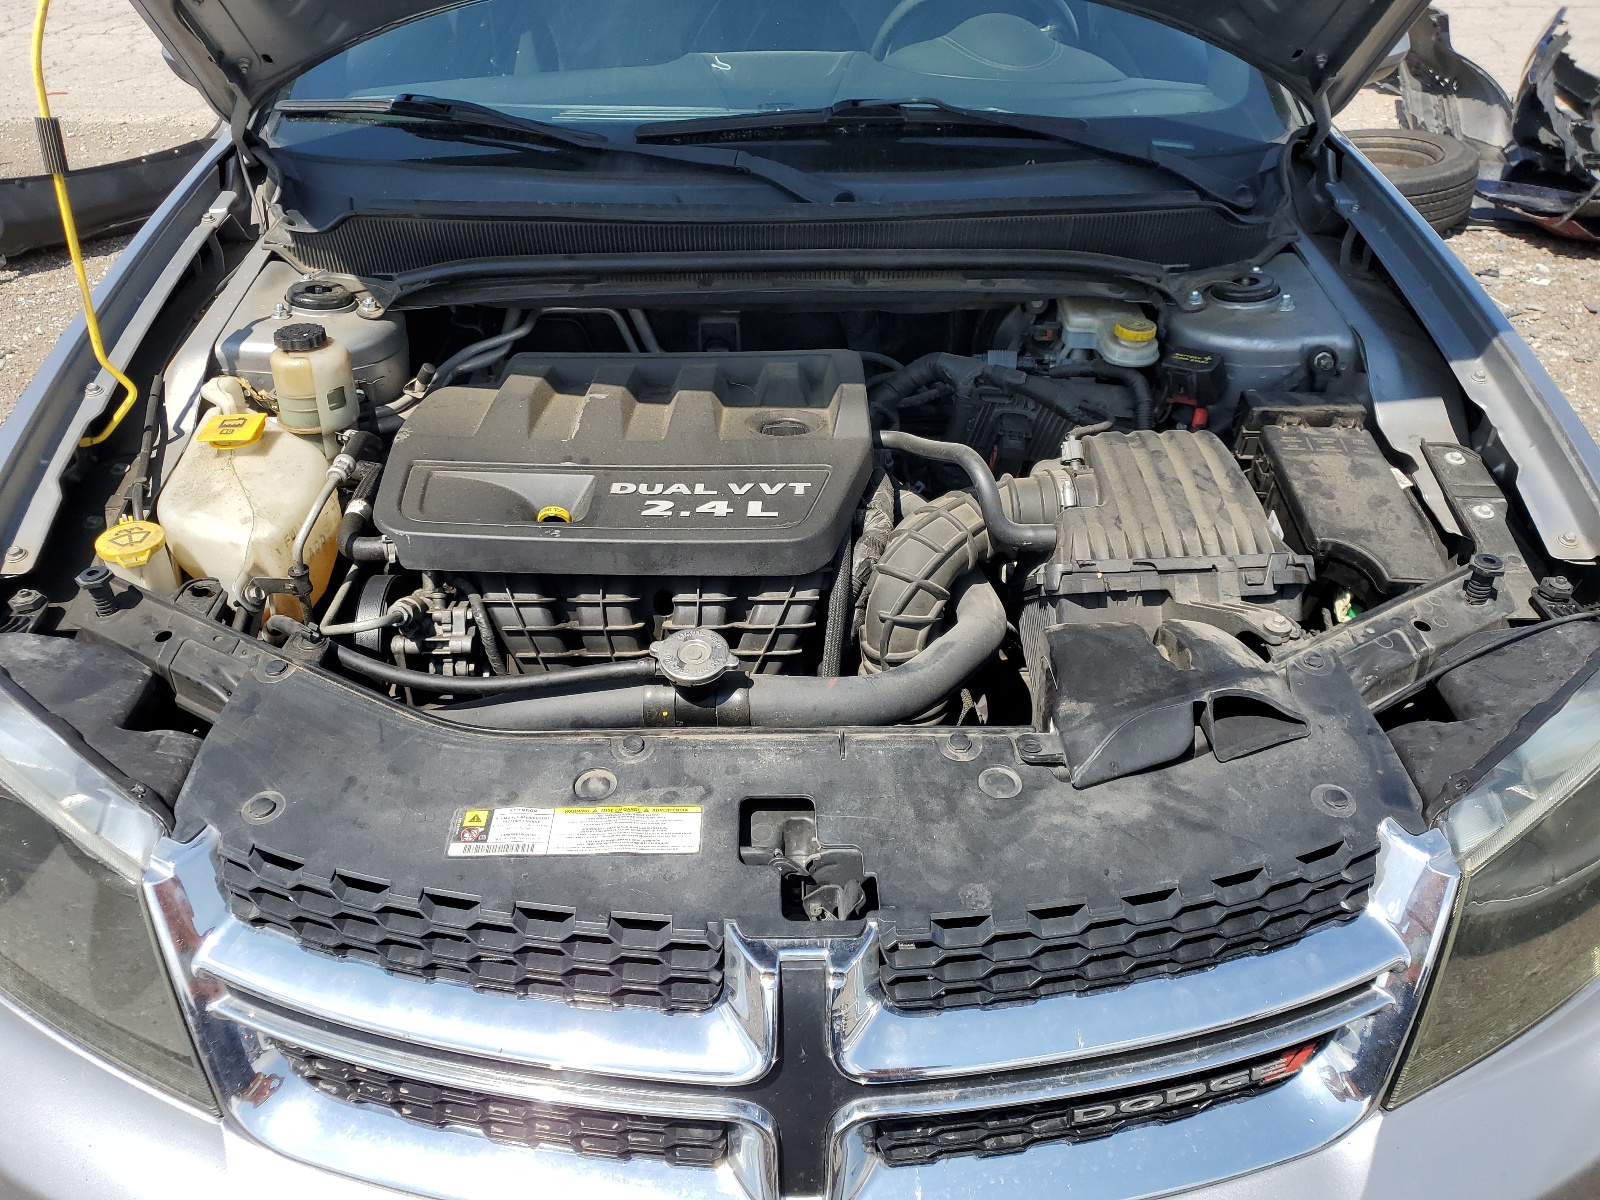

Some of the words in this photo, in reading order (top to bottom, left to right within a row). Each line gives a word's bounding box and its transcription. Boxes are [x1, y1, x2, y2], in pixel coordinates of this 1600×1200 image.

[610, 482, 718, 495] DUAL
[727, 482, 812, 495] VVT
[1073, 1058, 1288, 1123] DODGE
